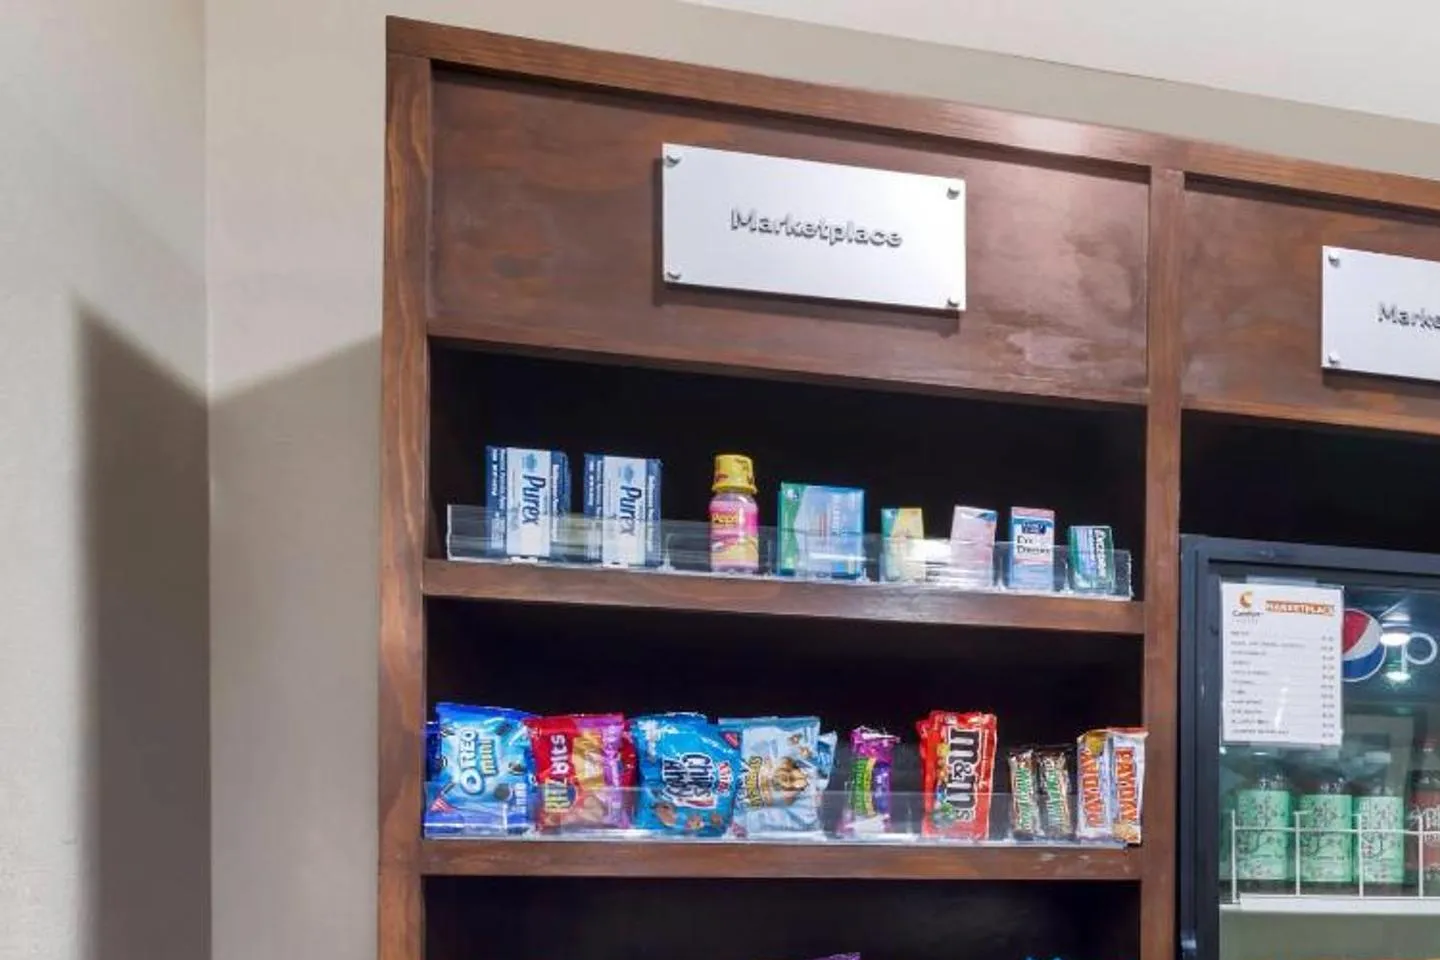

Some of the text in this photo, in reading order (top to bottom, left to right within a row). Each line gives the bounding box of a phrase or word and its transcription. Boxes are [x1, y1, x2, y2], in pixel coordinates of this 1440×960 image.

[730, 207, 903, 247] Marketplace
[522, 474, 547, 526] Purex
[620, 485, 642, 536] Purex
[459, 728, 484, 795] OREO
[480, 738, 499, 776] mini
